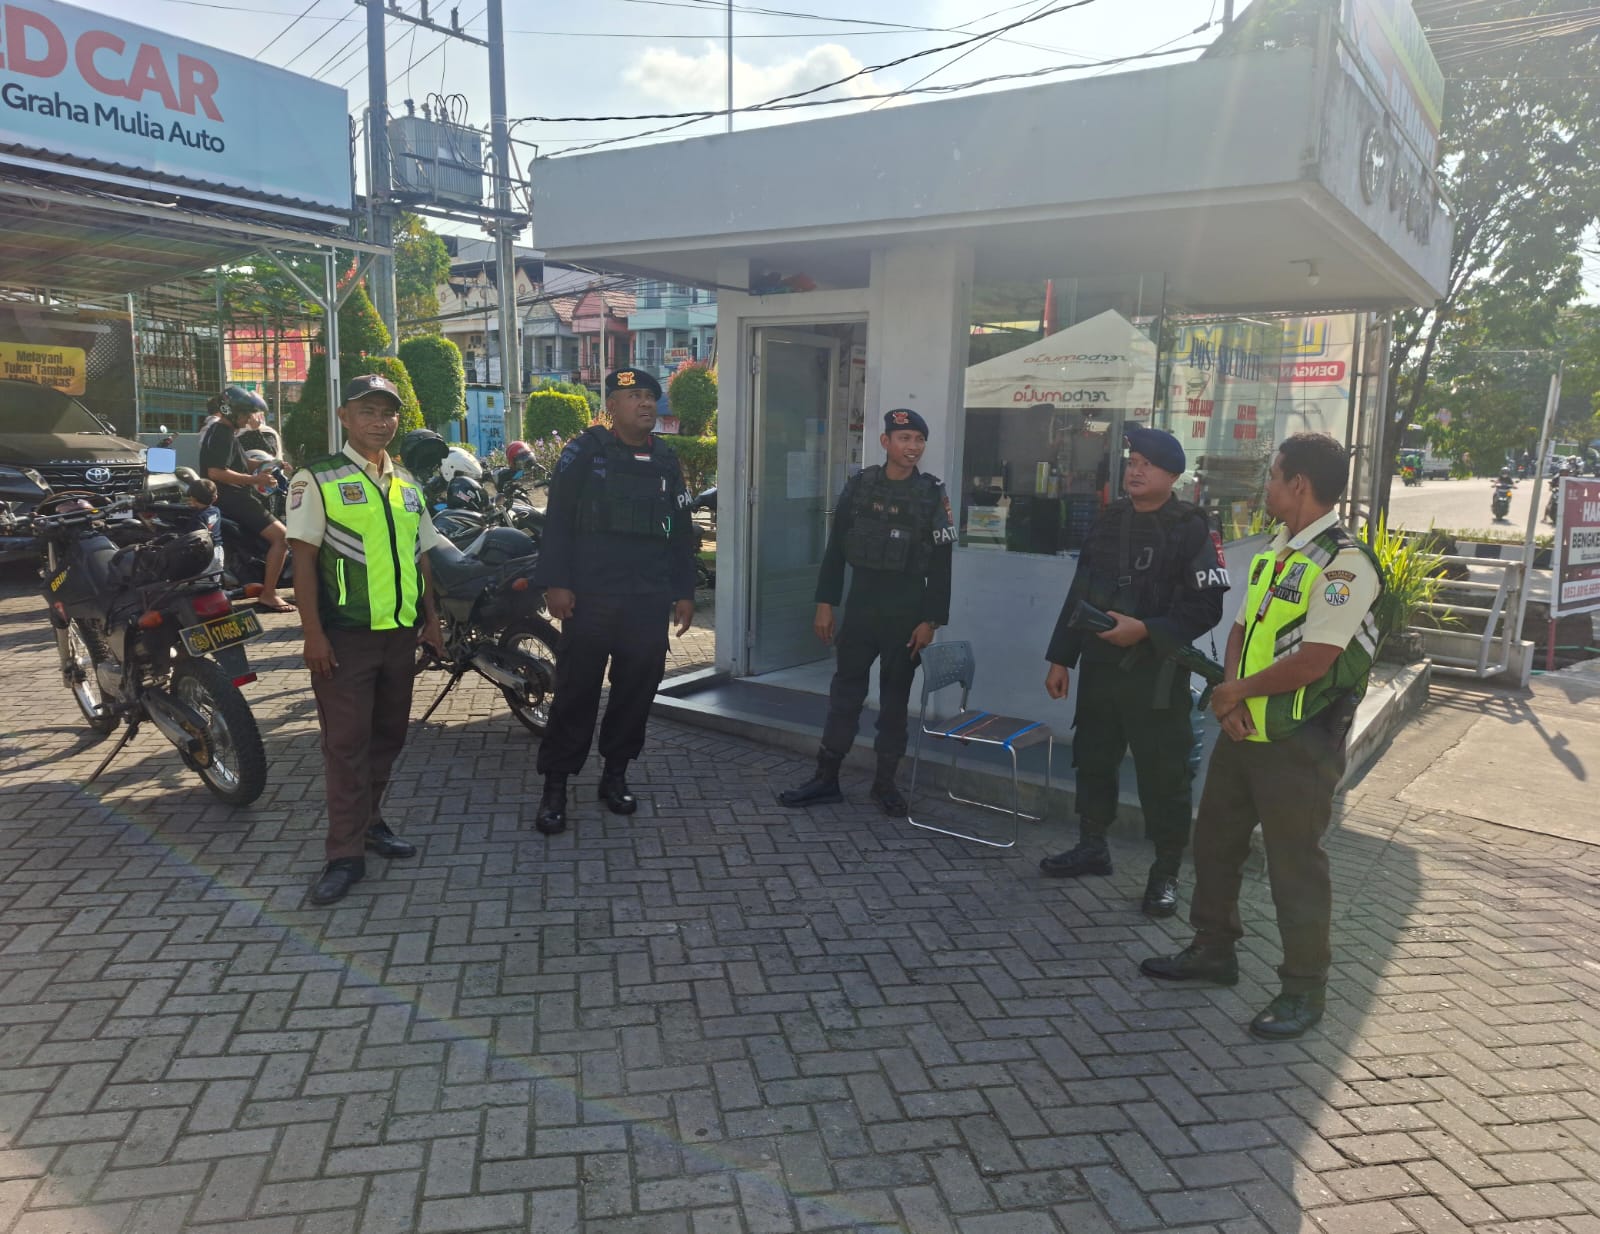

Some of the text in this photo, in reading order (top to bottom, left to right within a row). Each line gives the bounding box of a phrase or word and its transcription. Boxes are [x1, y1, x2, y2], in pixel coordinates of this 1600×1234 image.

[0, 3, 68, 78] D
[1, 83, 225, 153] Graha Mulia Auto
[4, 362, 76, 376] Tukar Tambah
[16, 350, 63, 364] Melayani
